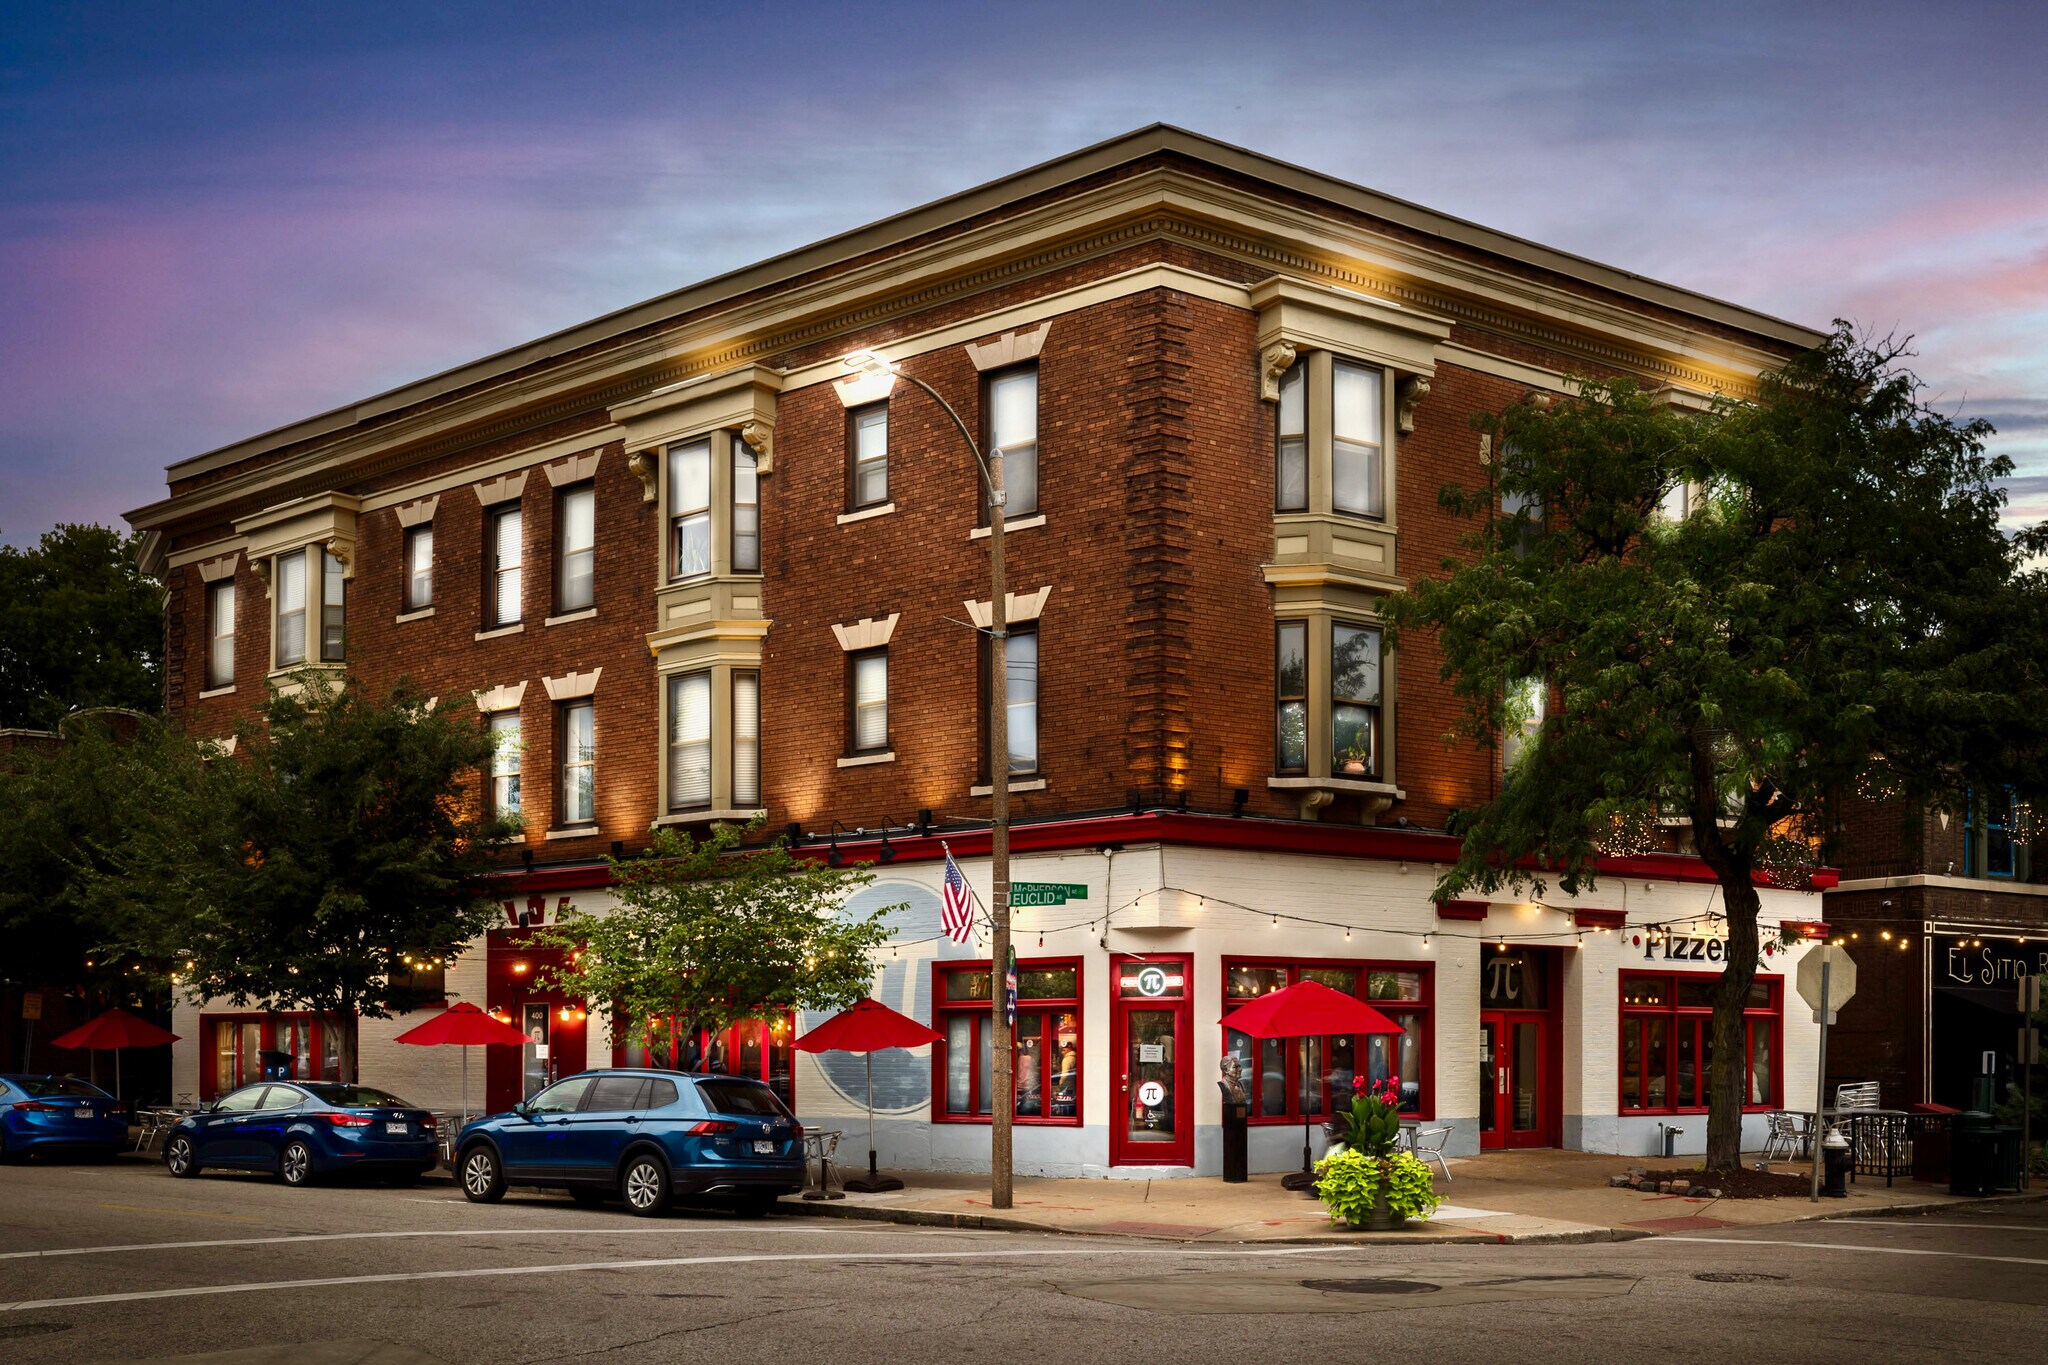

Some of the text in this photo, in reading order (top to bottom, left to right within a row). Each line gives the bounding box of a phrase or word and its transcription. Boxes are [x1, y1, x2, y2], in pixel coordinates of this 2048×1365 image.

[1013, 892, 1055, 905] EUCLID
[1643, 924, 1731, 962] Pizzer
[531, 1012, 544, 1020] 400
[278, 1066, 285, 1077] P
